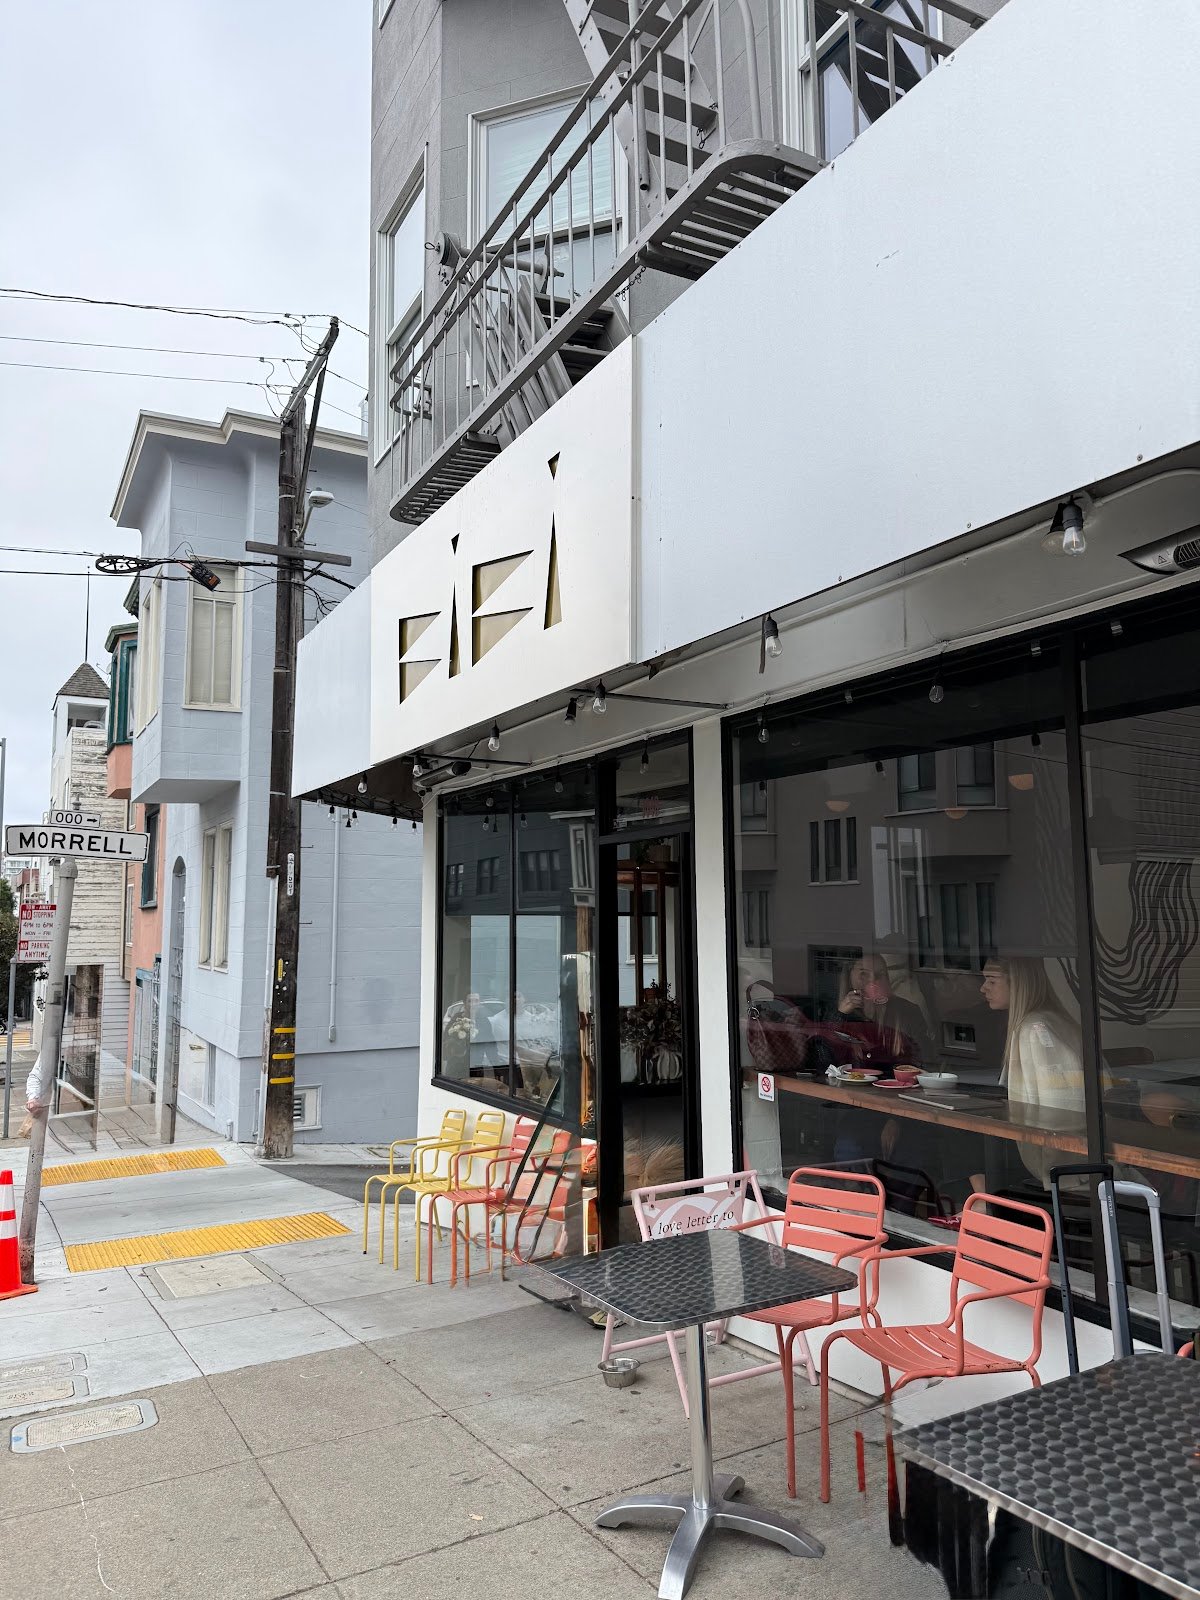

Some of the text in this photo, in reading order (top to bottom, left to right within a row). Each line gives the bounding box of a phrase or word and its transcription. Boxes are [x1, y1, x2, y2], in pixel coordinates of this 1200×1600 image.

[19, 831, 132, 855] MORRELL
[22, 911, 32, 919] NO
[658, 1221, 682, 1235] love
[686, 1214, 718, 1228] letter
[722, 1210, 734, 1220] to
